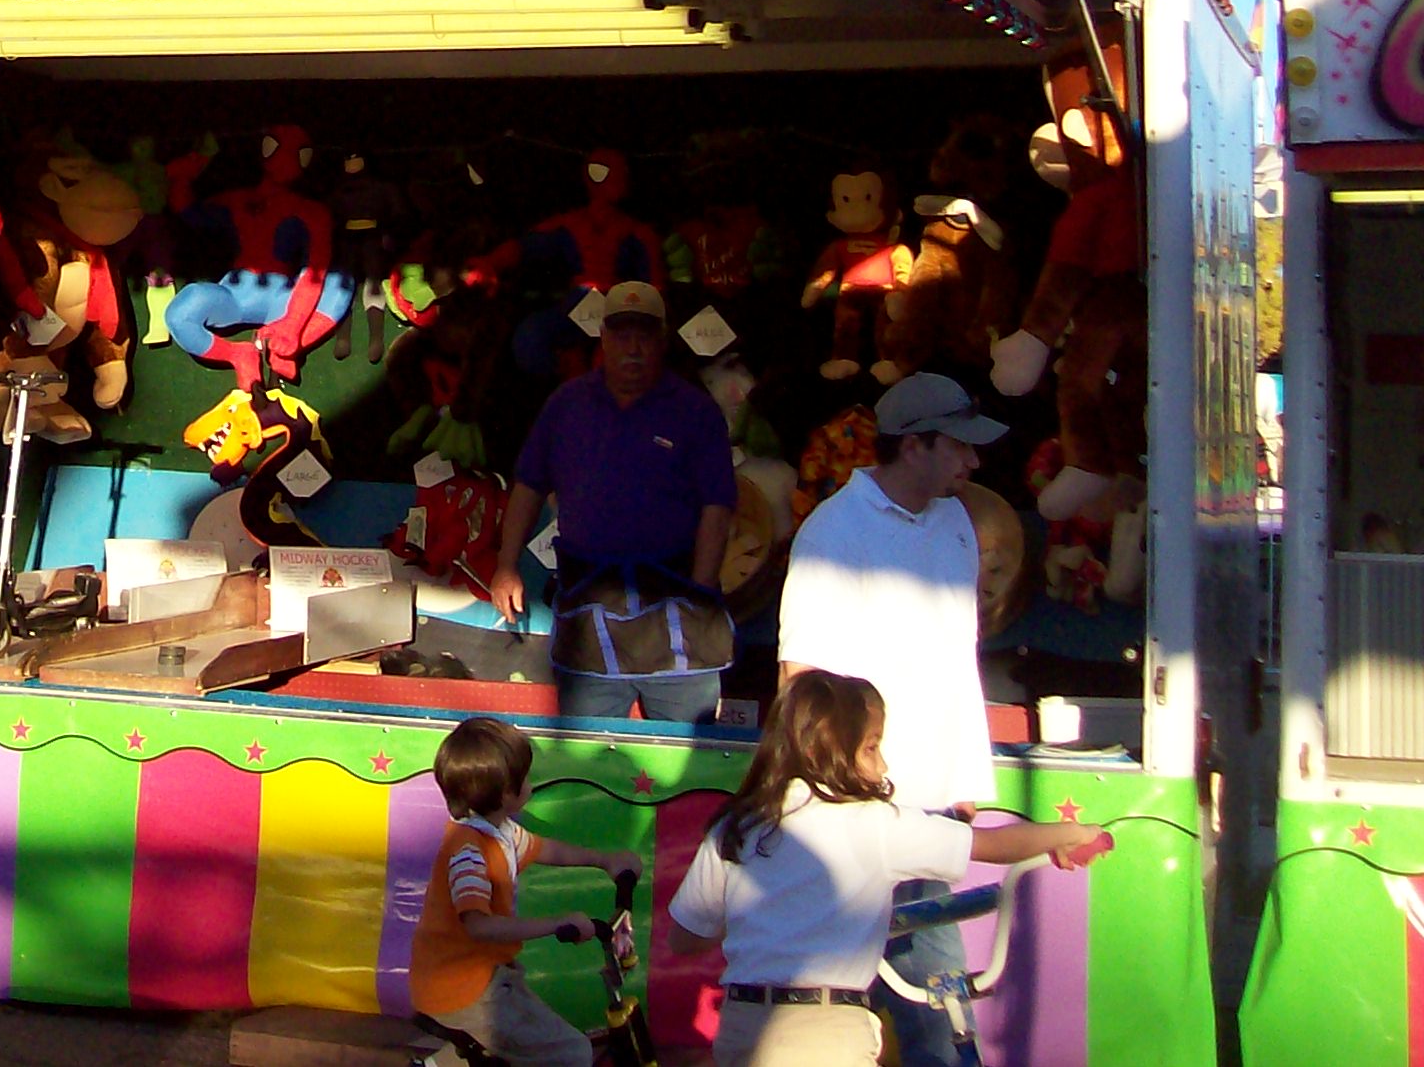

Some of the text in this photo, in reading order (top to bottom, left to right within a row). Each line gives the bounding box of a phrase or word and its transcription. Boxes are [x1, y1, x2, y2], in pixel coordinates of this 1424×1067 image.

[279, 552, 380, 566] MIDWAY HOCKEY
[718, 708, 746, 725] ets
